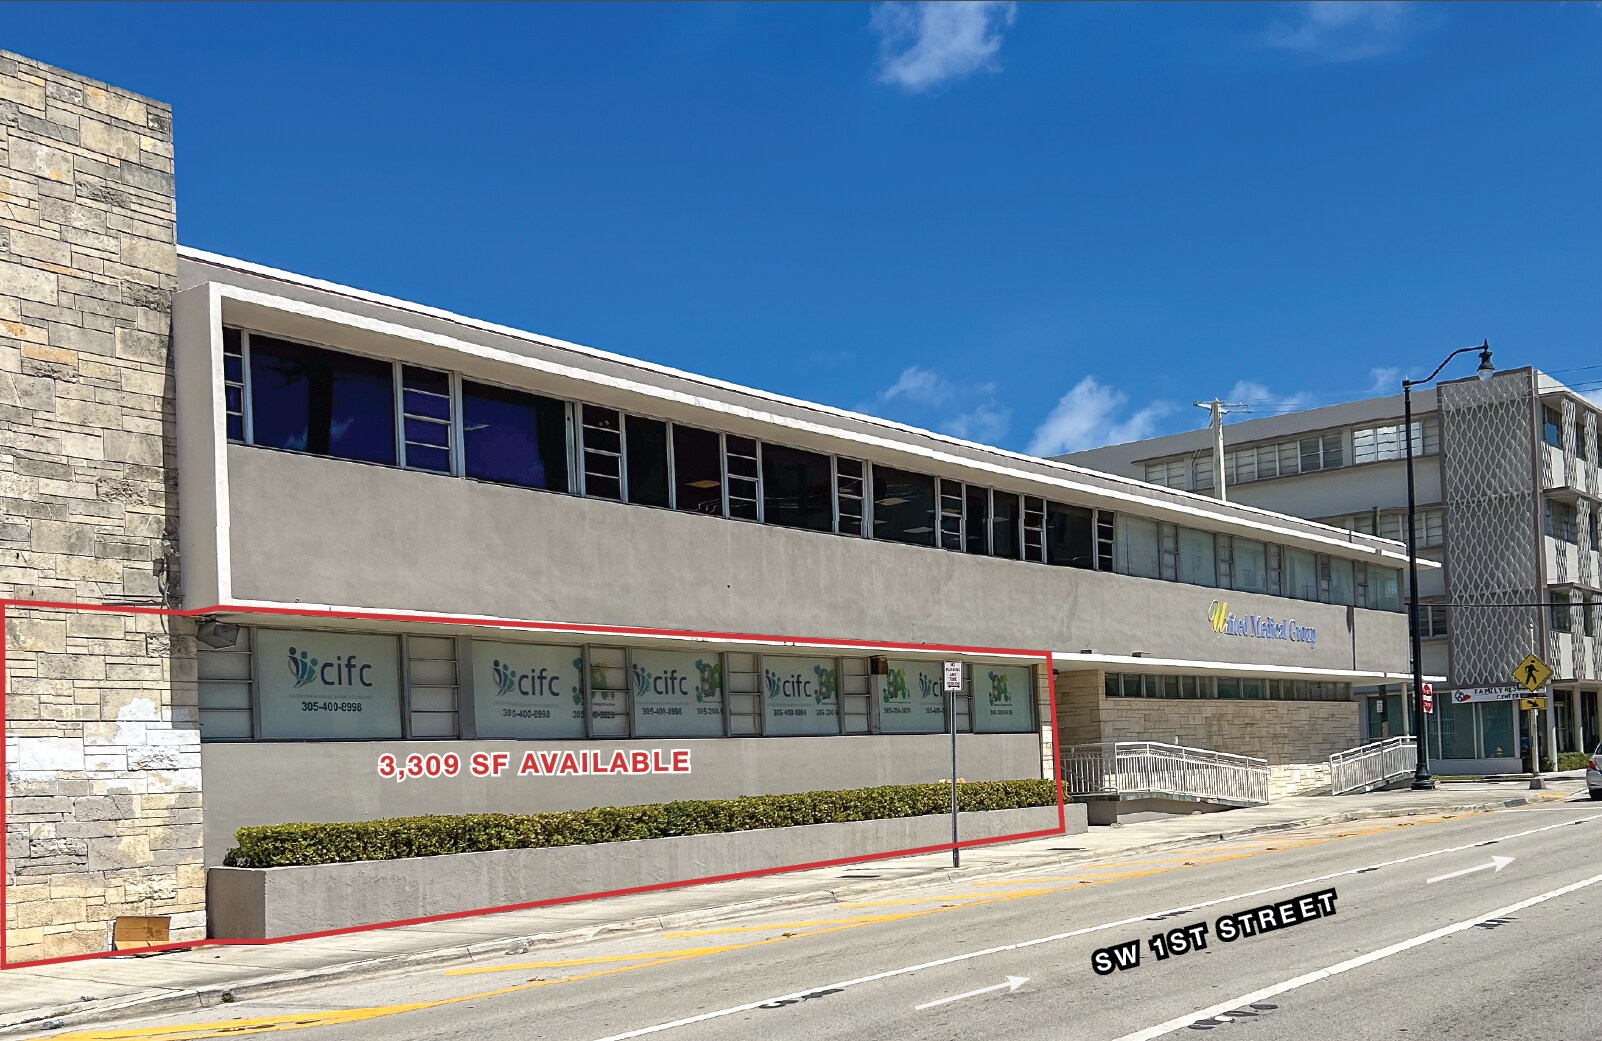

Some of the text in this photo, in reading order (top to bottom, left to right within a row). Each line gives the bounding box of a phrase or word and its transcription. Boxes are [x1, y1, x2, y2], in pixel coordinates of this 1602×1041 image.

[1208, 600, 1317, 649] United Medical Group
[320, 655, 373, 687] cifc
[518, 668, 560, 697] cifc
[653, 669, 688, 696] cifc
[782, 674, 812, 698] cifc
[1474, 687, 1503, 695] FAMILY
[301, 701, 362, 712] 305-400-8998
